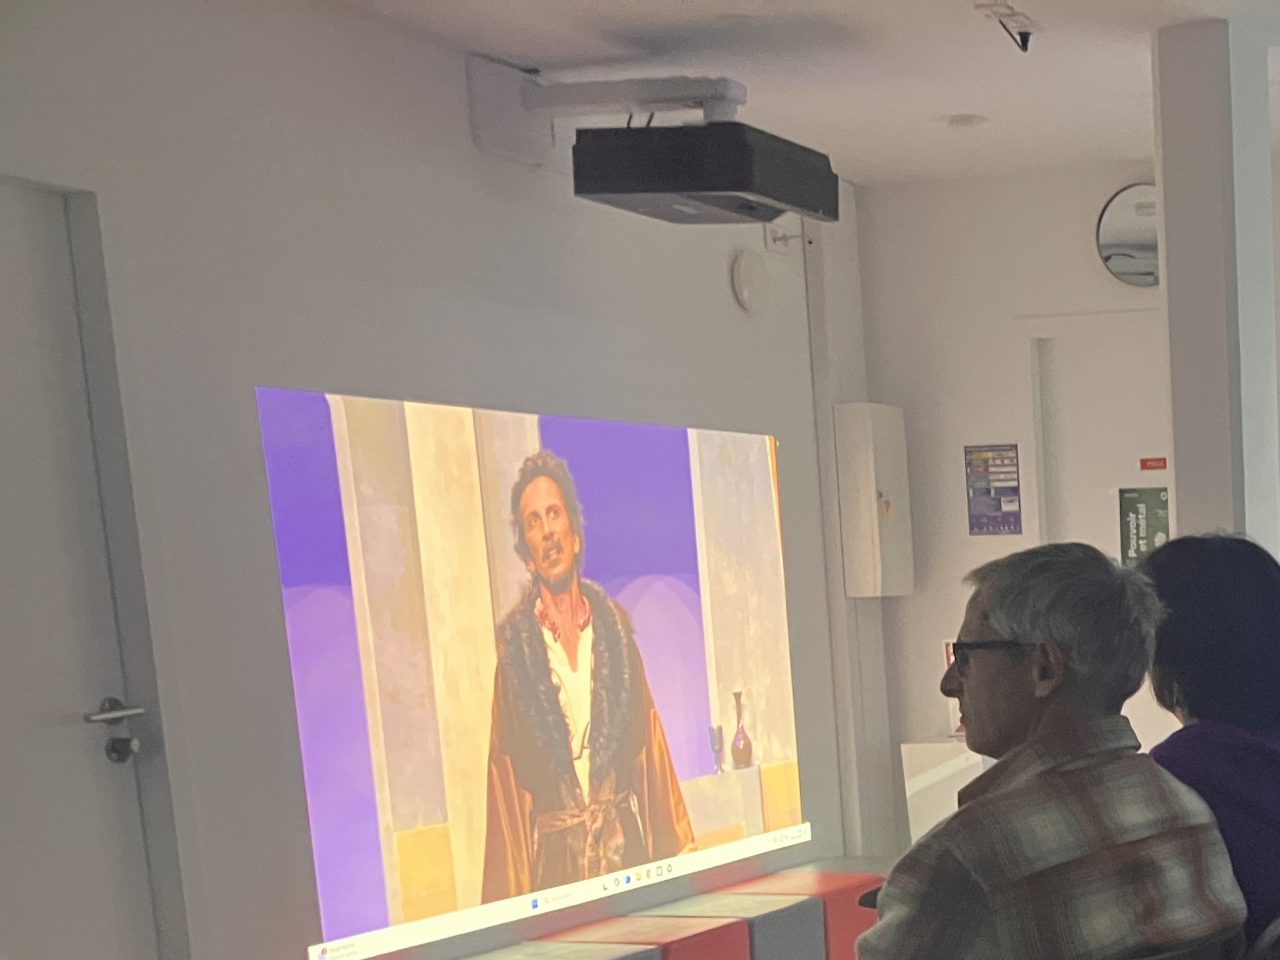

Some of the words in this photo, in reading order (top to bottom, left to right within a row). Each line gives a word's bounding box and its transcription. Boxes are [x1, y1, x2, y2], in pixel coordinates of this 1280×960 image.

[1126, 511, 1138, 558] Pouvoir
[1136, 503, 1147, 538] métal
[1138, 539, 1147, 552] et
